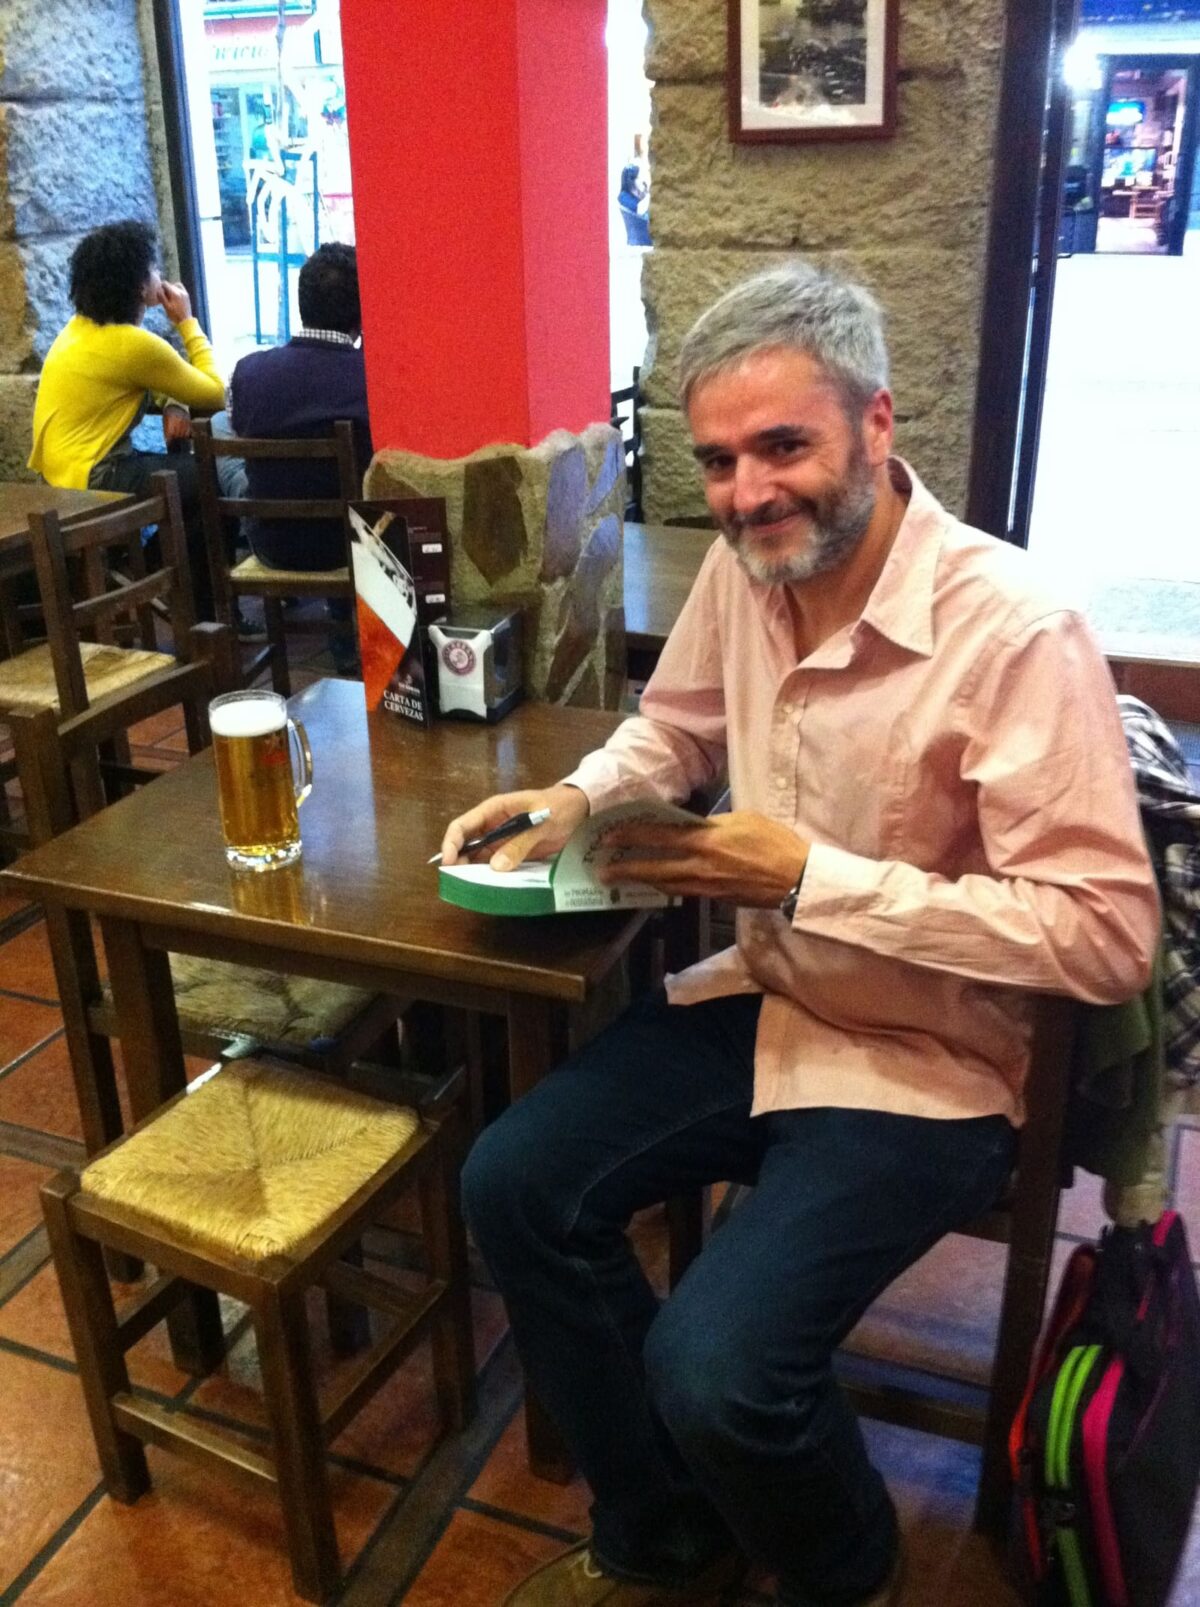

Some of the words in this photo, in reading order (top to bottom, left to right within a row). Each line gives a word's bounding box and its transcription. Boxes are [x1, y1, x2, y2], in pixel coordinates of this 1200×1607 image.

[383, 689, 411, 706] CARTA
[411, 699, 423, 711] DE
[384, 700, 424, 721] CERVEZAS
